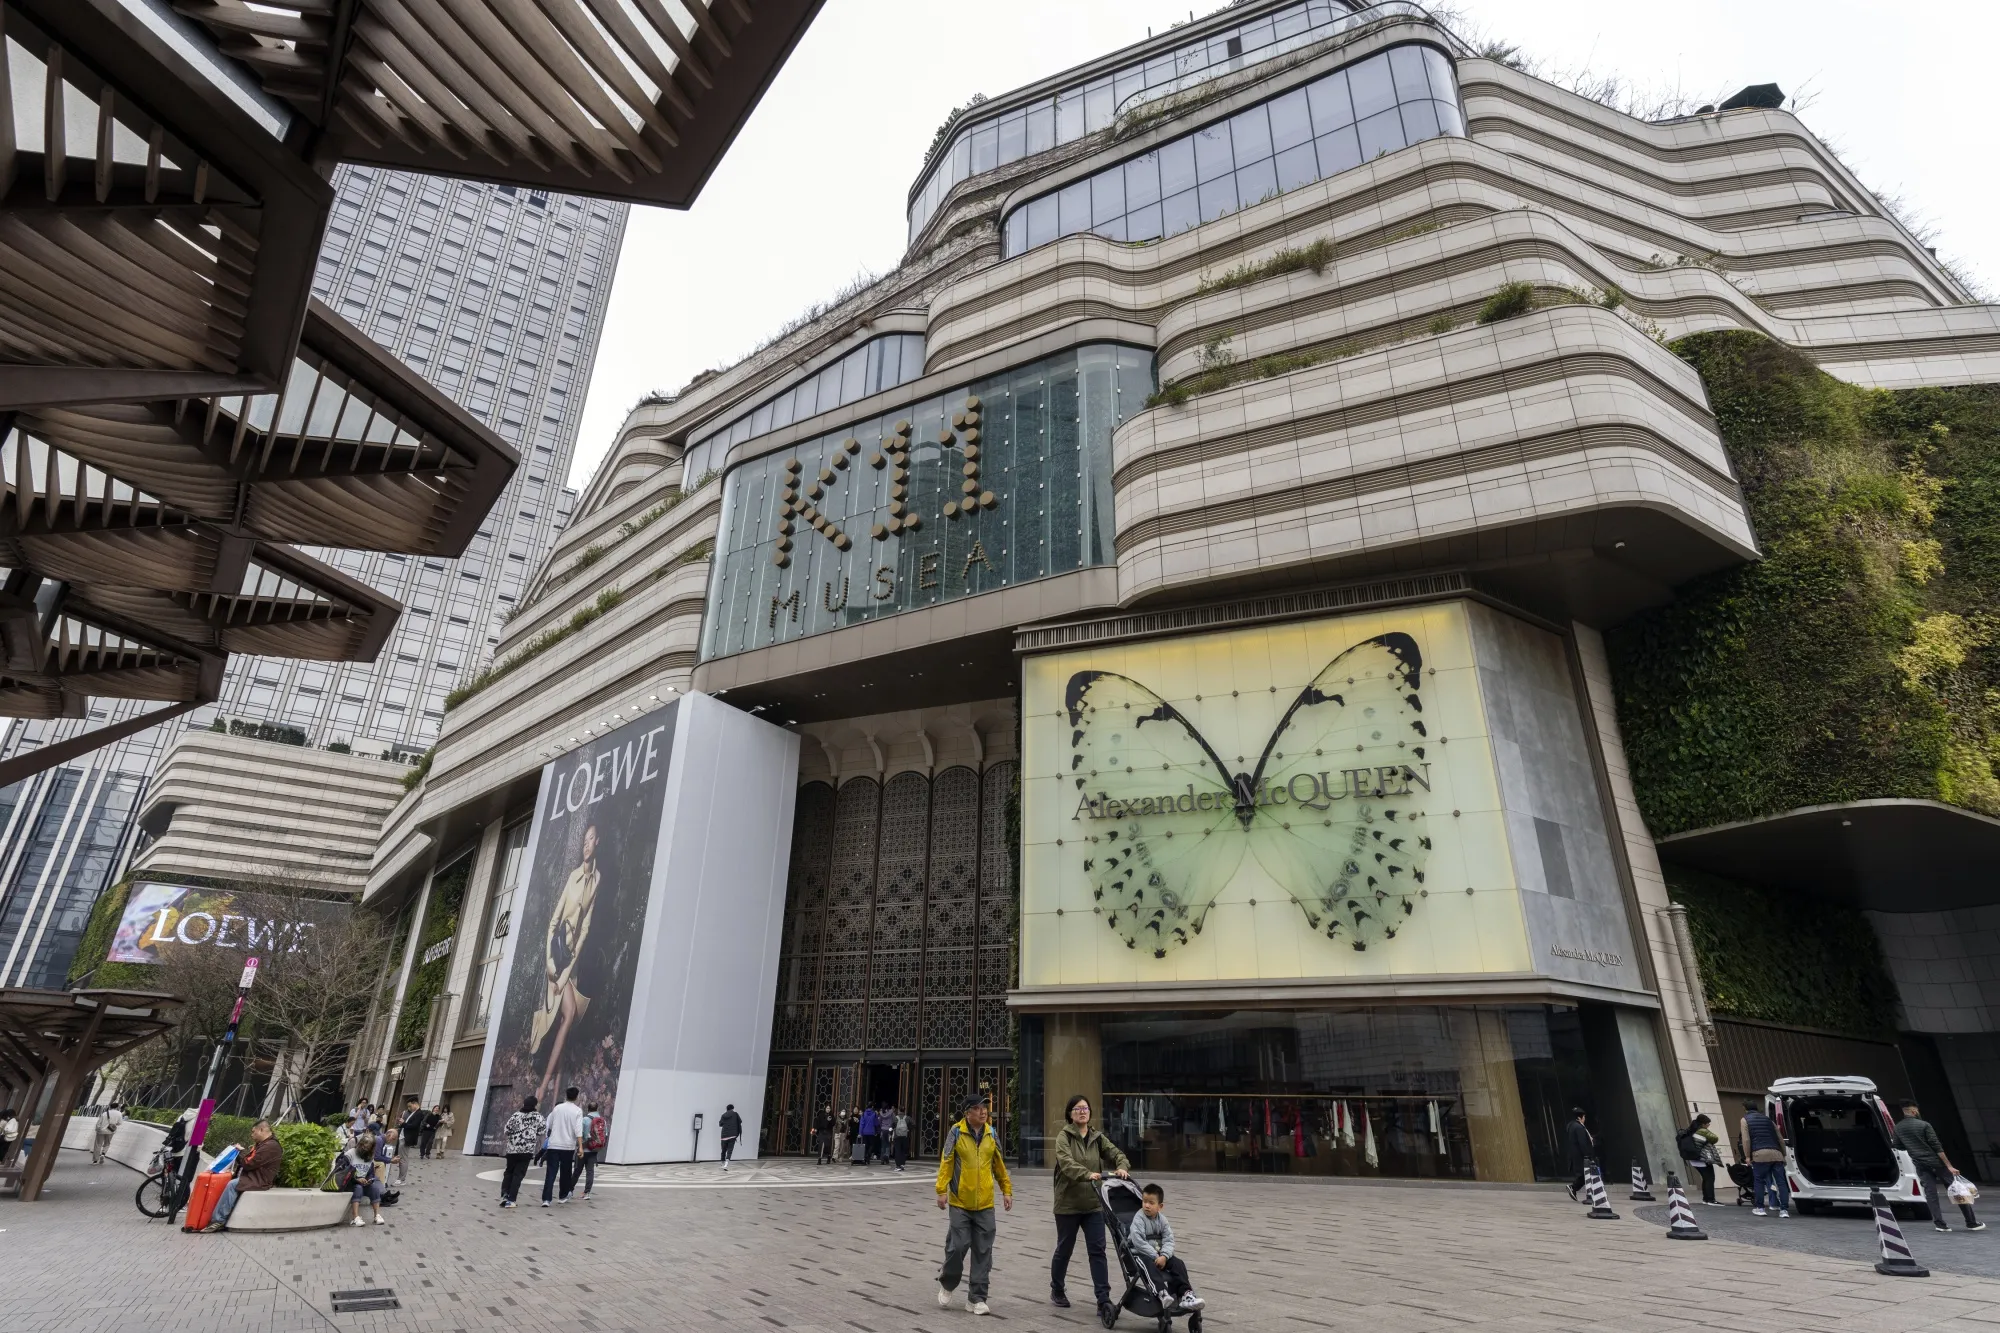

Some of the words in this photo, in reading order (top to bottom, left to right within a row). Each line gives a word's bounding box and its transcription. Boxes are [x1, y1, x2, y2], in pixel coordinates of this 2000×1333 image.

[773, 395, 998, 569] K11
[768, 540, 994, 628] MUSEA
[550, 725, 665, 821] LOEWE
[1072, 784, 1228, 821] Alexander
[1235, 763, 1432, 811] McQUEEN
